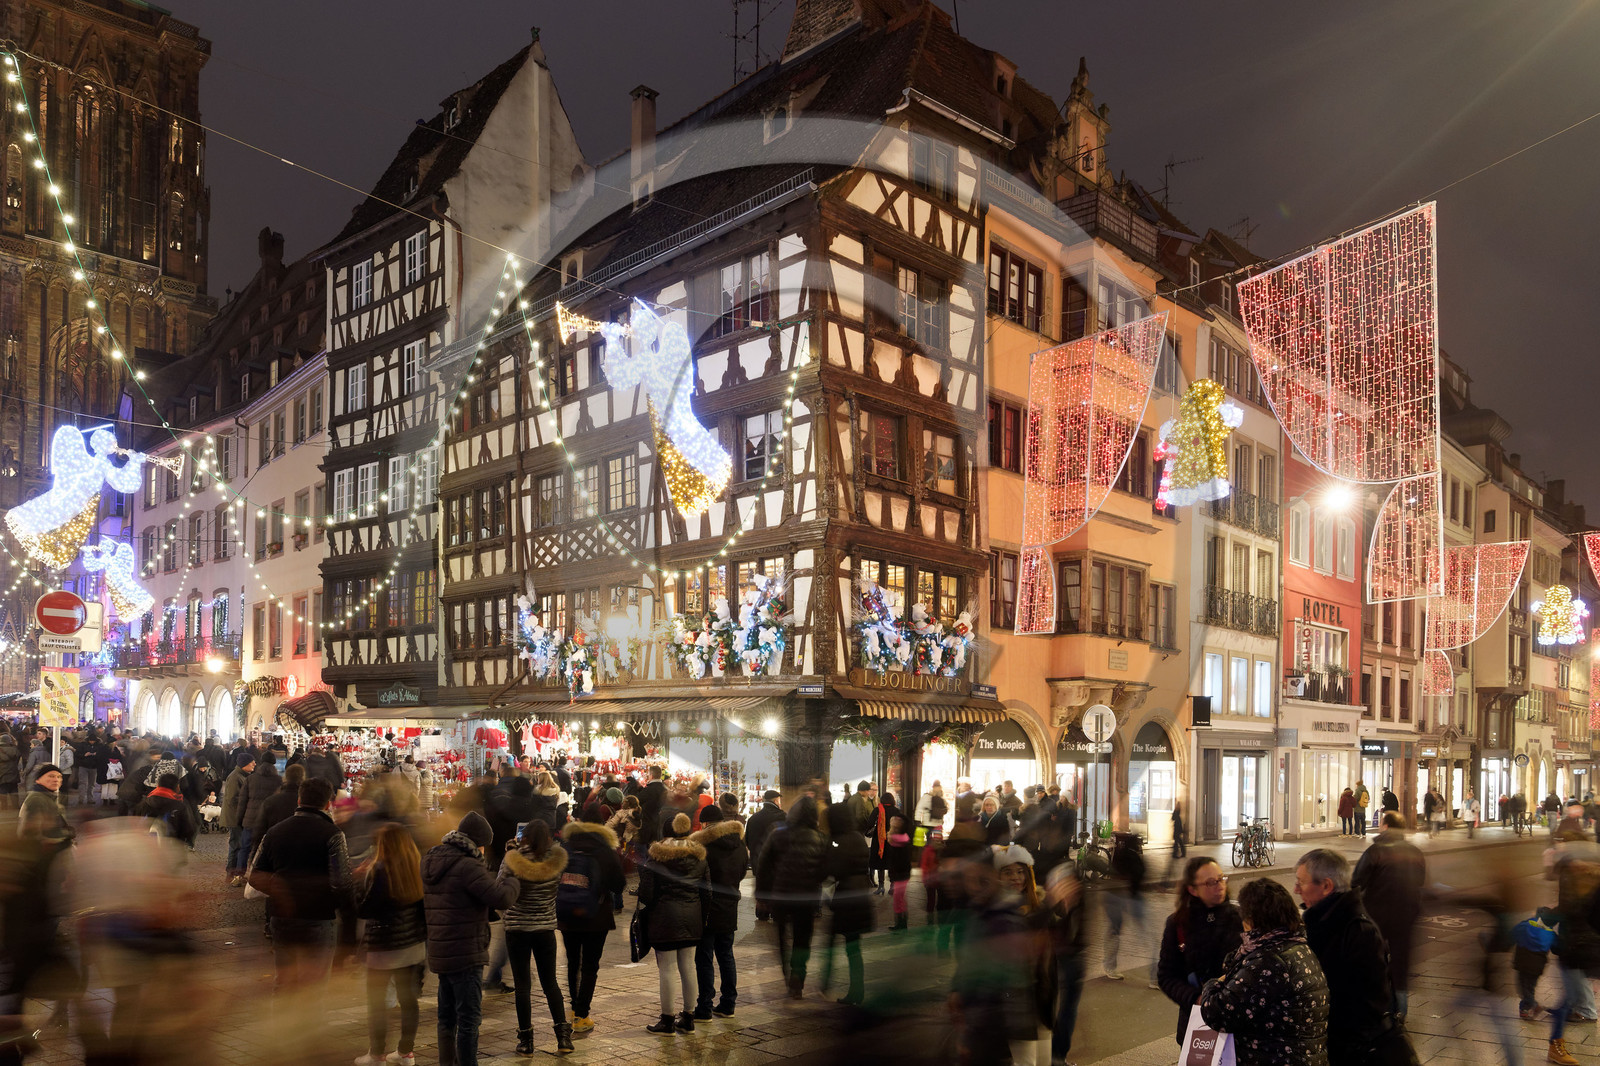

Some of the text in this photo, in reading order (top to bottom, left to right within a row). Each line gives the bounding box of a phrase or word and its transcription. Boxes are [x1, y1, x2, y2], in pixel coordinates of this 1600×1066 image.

[1303, 598, 1343, 625] HOTEL
[979, 739, 1026, 751] The Kooples
[1062, 742, 1074, 750] The
[1133, 743, 1167, 754] The Kooples
